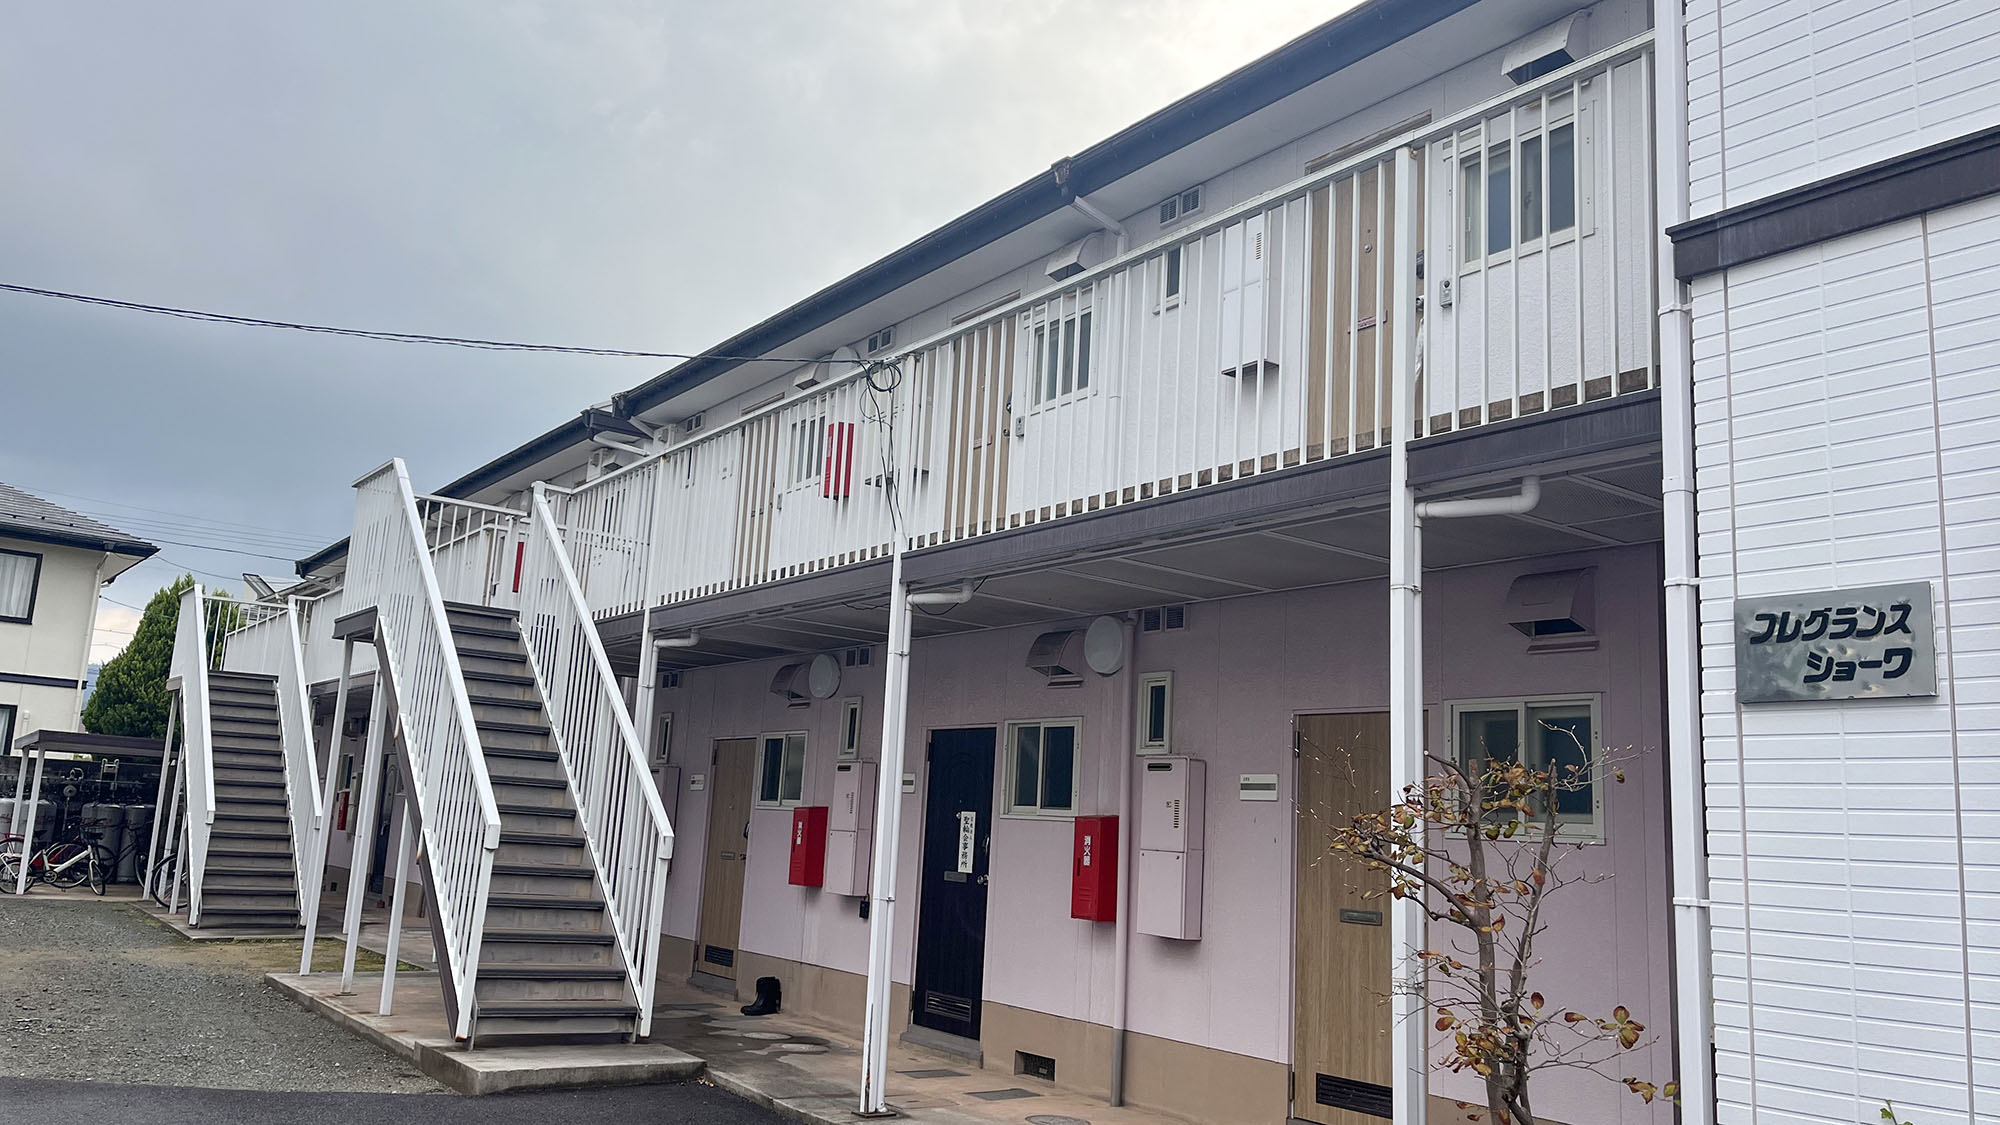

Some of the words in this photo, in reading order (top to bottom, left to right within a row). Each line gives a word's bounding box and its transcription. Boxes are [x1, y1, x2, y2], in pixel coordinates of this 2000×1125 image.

[1750, 603, 1912, 645] フレグランス
[1803, 647, 1913, 683] ショーワ
[1083, 835, 1091, 866] 消火器
